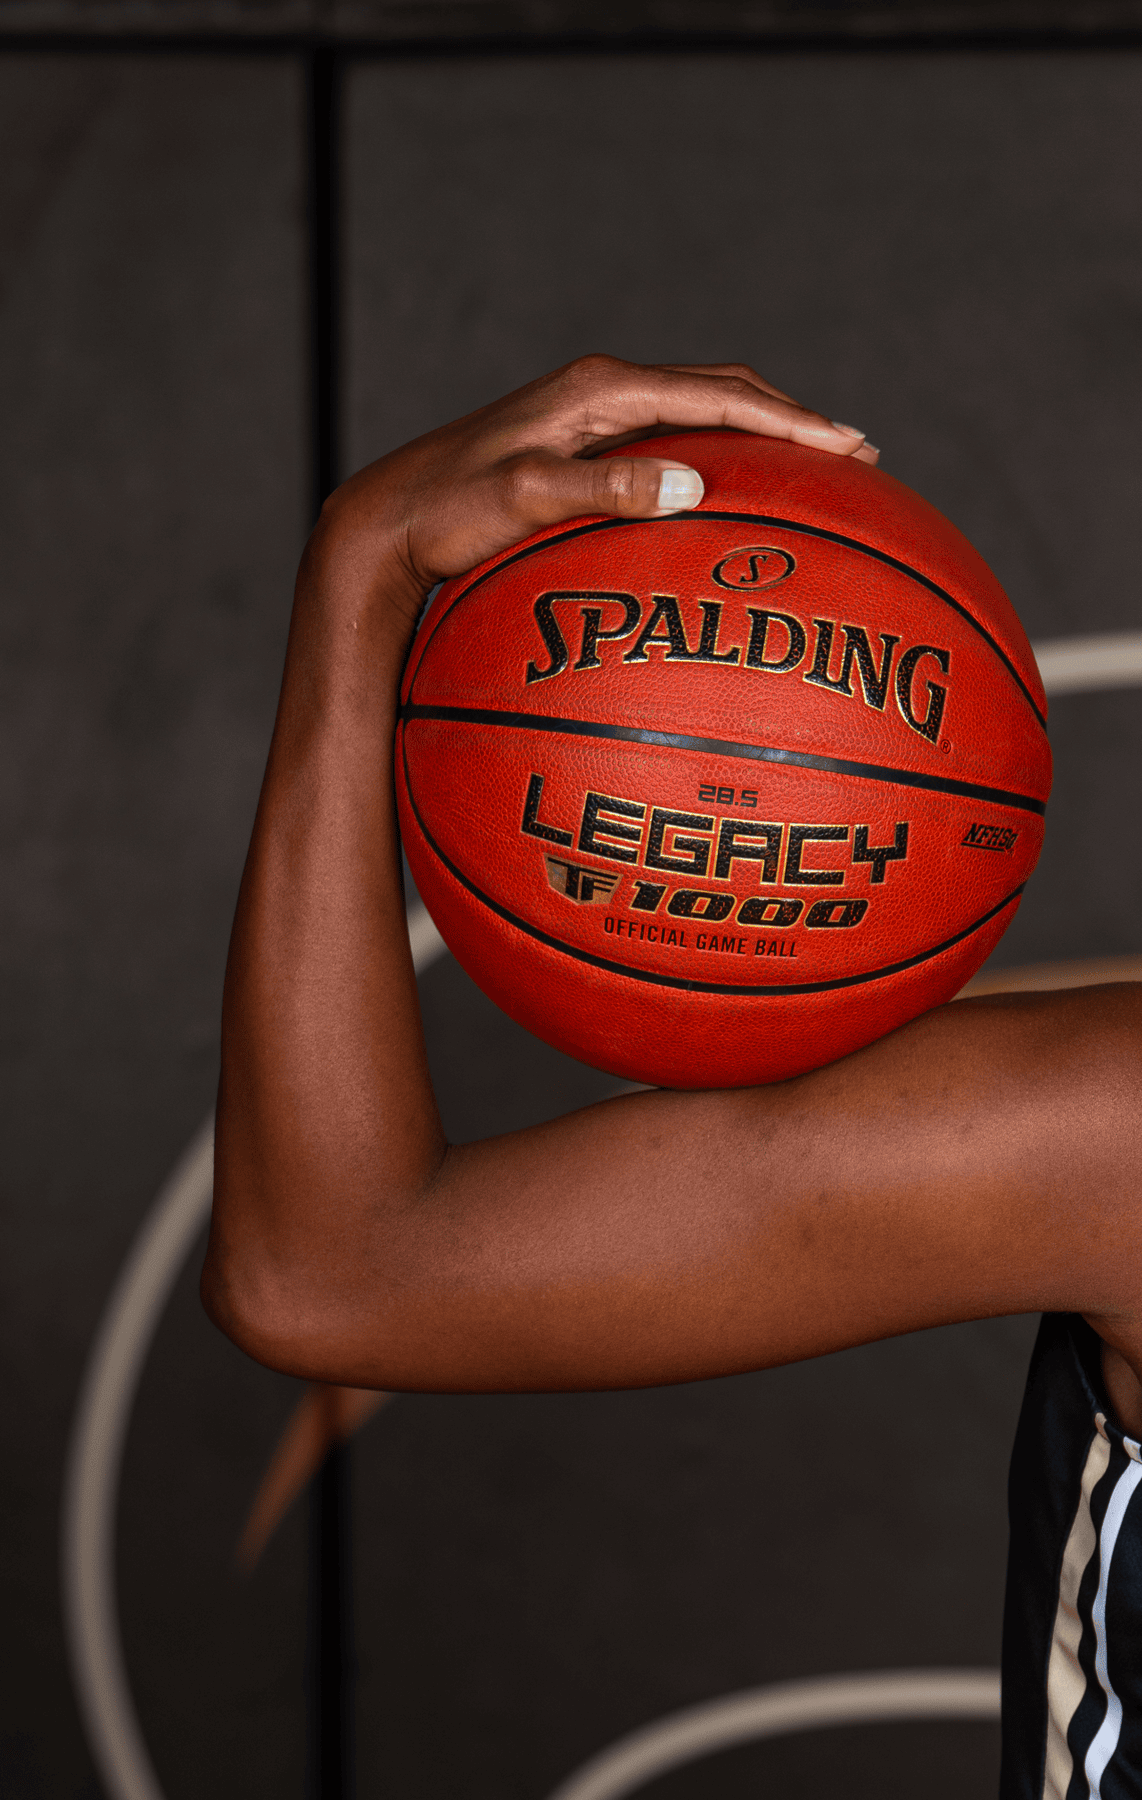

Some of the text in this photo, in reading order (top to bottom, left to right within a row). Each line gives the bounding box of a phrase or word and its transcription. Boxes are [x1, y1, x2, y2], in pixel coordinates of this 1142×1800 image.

[698, 784, 759, 808] 28.5
[520, 773, 909, 887] LEGACY
[628, 879, 870, 930] 1000
[604, 917, 798, 957] OFFICIAL GAME BALL
